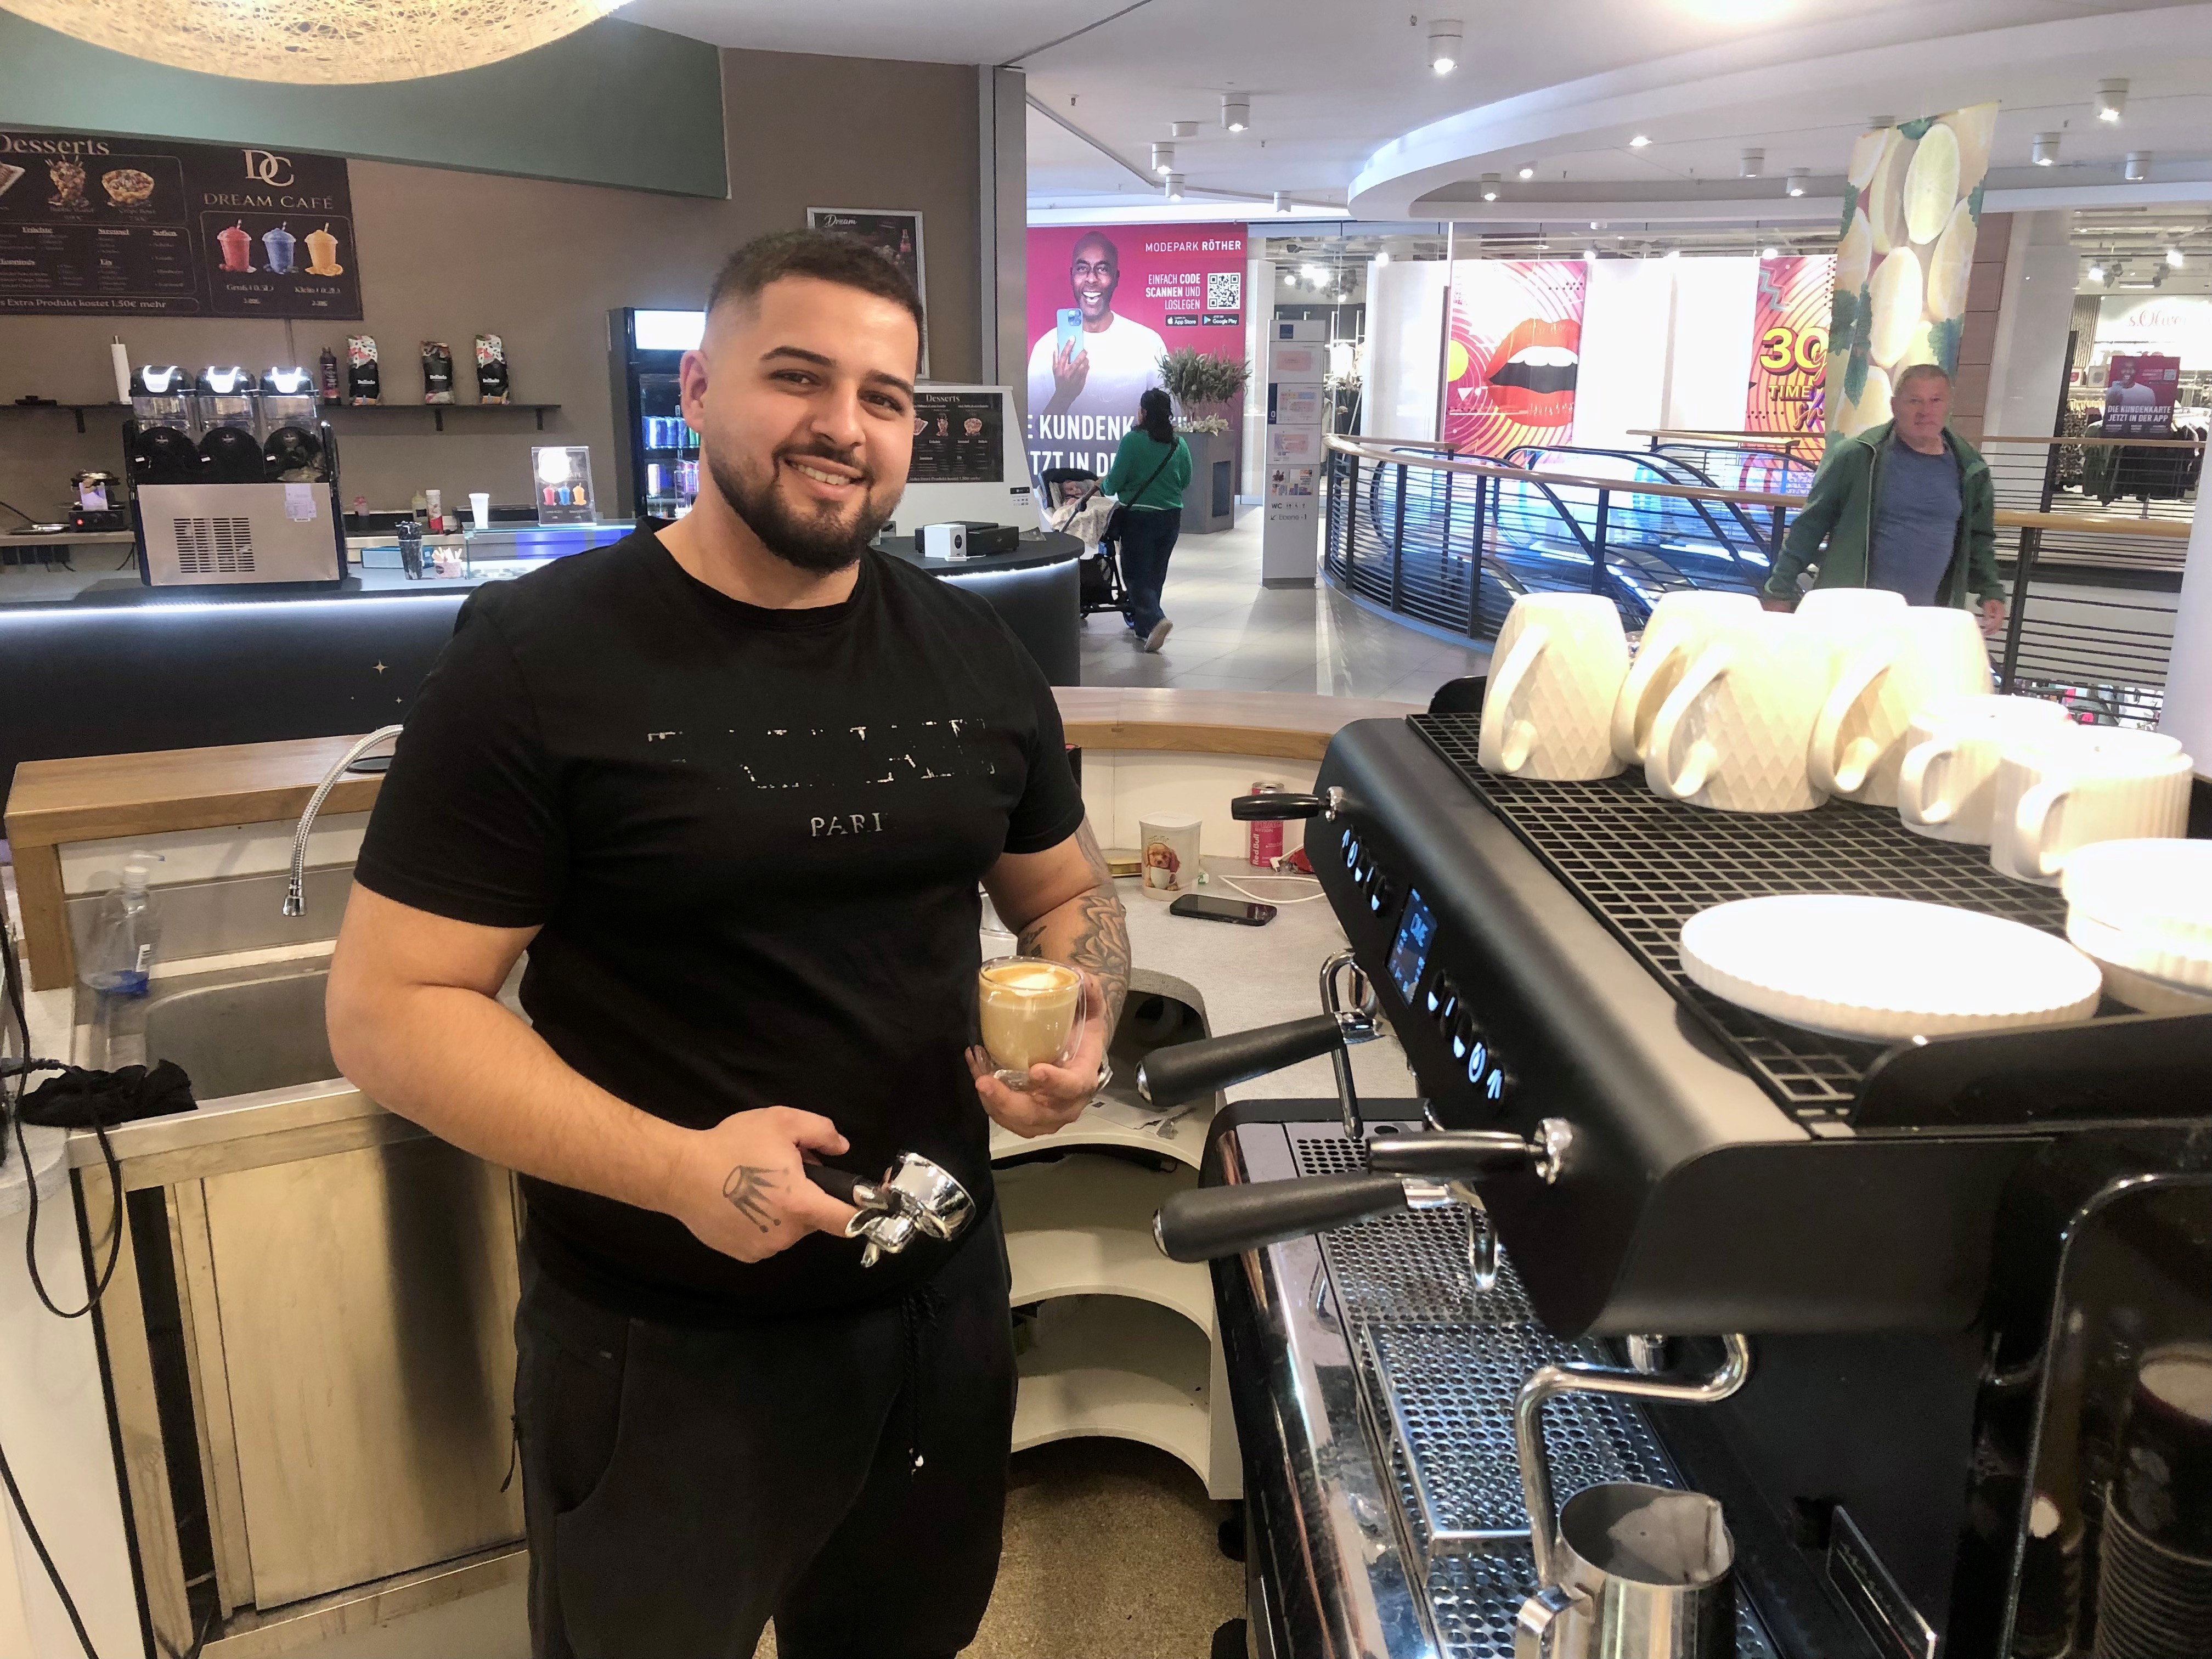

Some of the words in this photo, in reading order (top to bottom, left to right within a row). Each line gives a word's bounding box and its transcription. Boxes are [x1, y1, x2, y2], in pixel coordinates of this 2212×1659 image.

[204, 193, 273, 207] DREAM
[280, 195, 334, 210] CAFÉ
[1145, 241, 1199, 252] MODEPARK
[1201, 239, 1242, 251] RÖTHER
[1148, 274, 1177, 285] EINFACH
[1180, 273, 1201, 284] CODE
[1146, 286, 1183, 298] SCANNEN
[1185, 286, 1200, 297] UND
[1165, 299, 1200, 310] LOSLEGEN
[926, 394, 960, 403] Desserts
[1769, 384, 1815, 402] TIME
[810, 812, 884, 837] PARI
